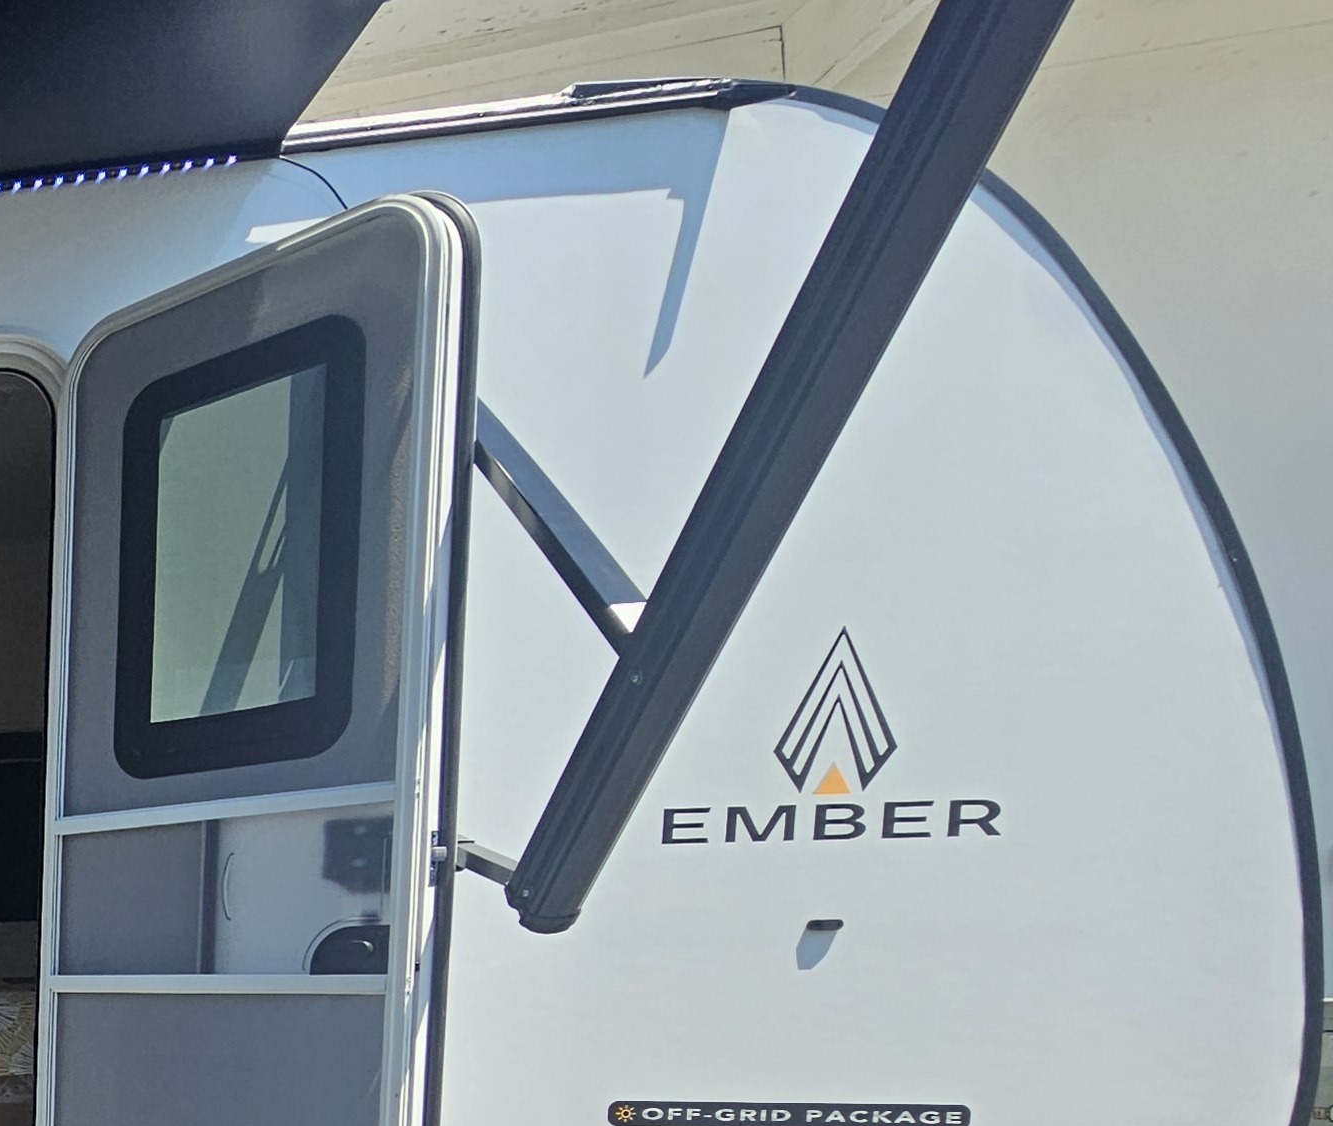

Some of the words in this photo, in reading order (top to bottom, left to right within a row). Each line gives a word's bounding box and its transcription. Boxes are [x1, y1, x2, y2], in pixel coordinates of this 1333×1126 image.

[661, 799, 1002, 845] EMBER
[640, 1107, 793, 1123] OFF-GRID
[805, 1109, 964, 1125] PACKAGE
